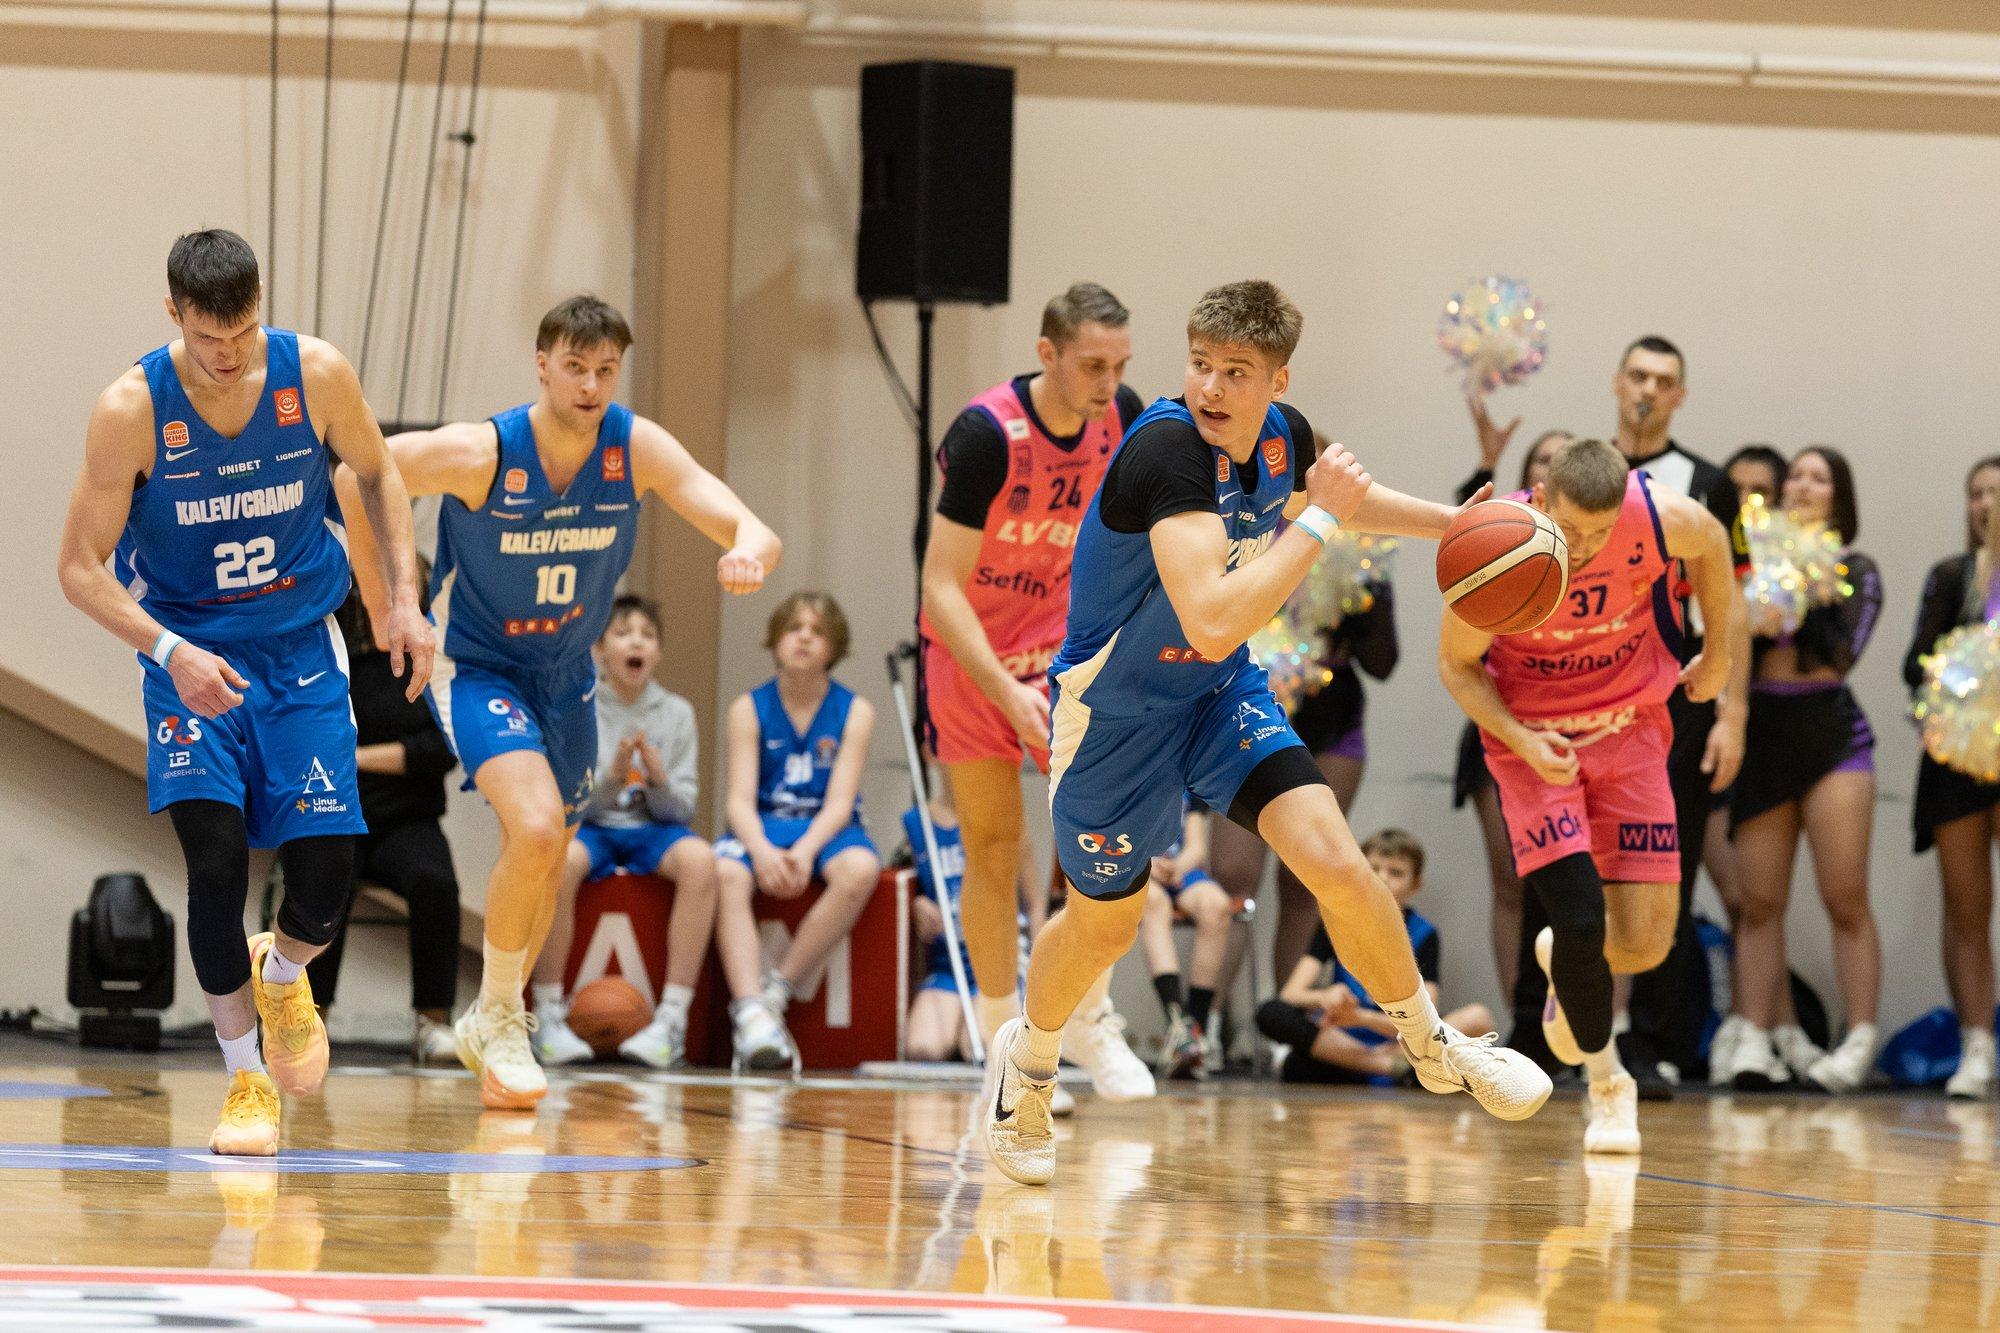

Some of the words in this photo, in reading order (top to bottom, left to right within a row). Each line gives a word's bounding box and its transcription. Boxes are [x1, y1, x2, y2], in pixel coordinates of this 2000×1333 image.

[165, 428, 187, 436] BURGER
[166, 433, 188, 443] KING
[275, 447, 313, 462] LIGNATOR
[217, 459, 261, 476] UNIBET
[175, 479, 304, 526] KALEV/CRAMO
[1047, 474, 1082, 512] 24
[500, 525, 618, 554] KALEV/CRAMO
[213, 536, 278, 590] 22
[535, 564, 577, 606] 10
[1569, 584, 1607, 619] 37
[312, 797, 337, 806] Linus
[313, 803, 347, 813] Medical
